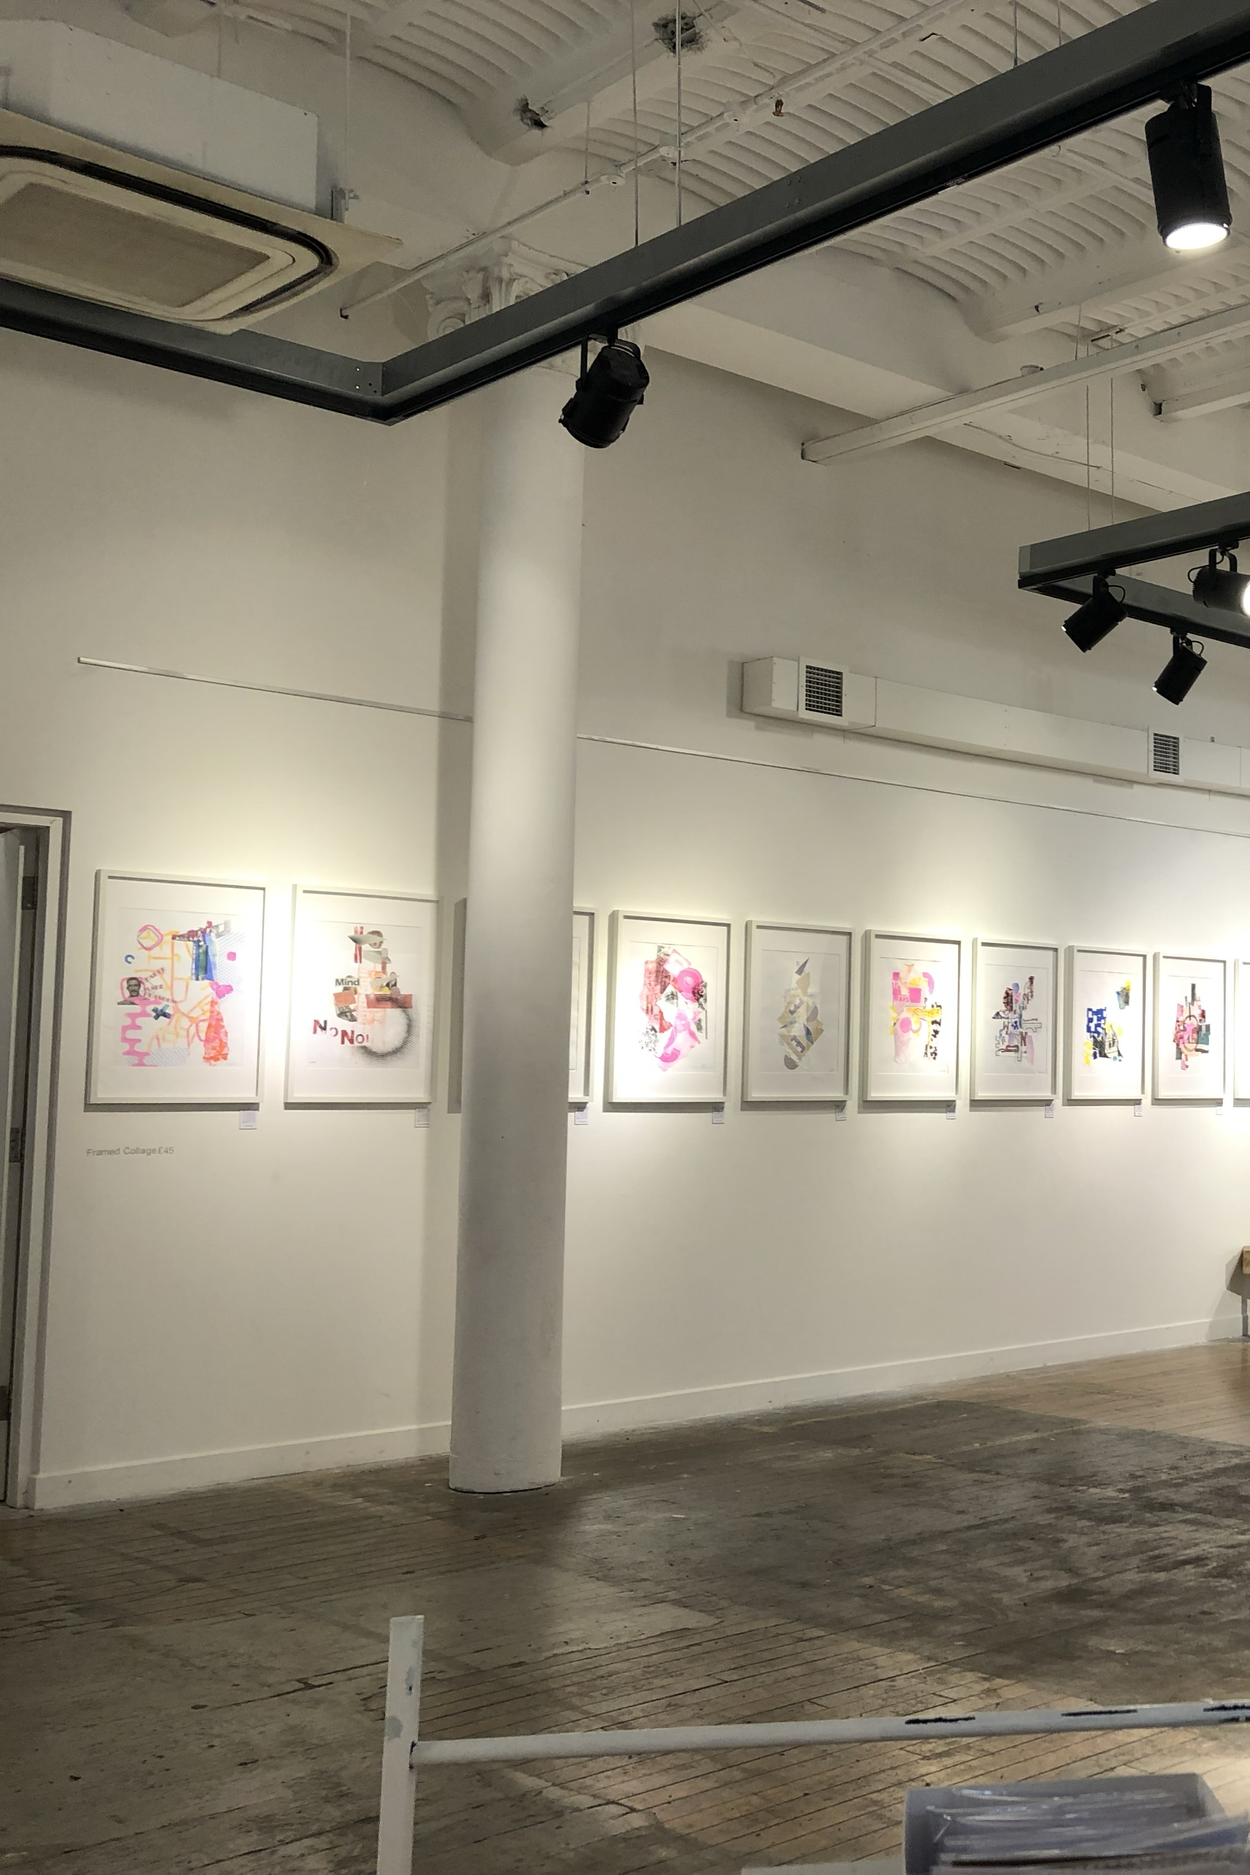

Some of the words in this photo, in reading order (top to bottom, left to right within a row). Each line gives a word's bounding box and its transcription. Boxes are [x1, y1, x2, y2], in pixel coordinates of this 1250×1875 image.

[335, 978, 360, 986] Mind
[86, 1147, 121, 1157] Framed
[122, 1146, 157, 1157] Collage
[157, 1146, 175, 1155] £45
